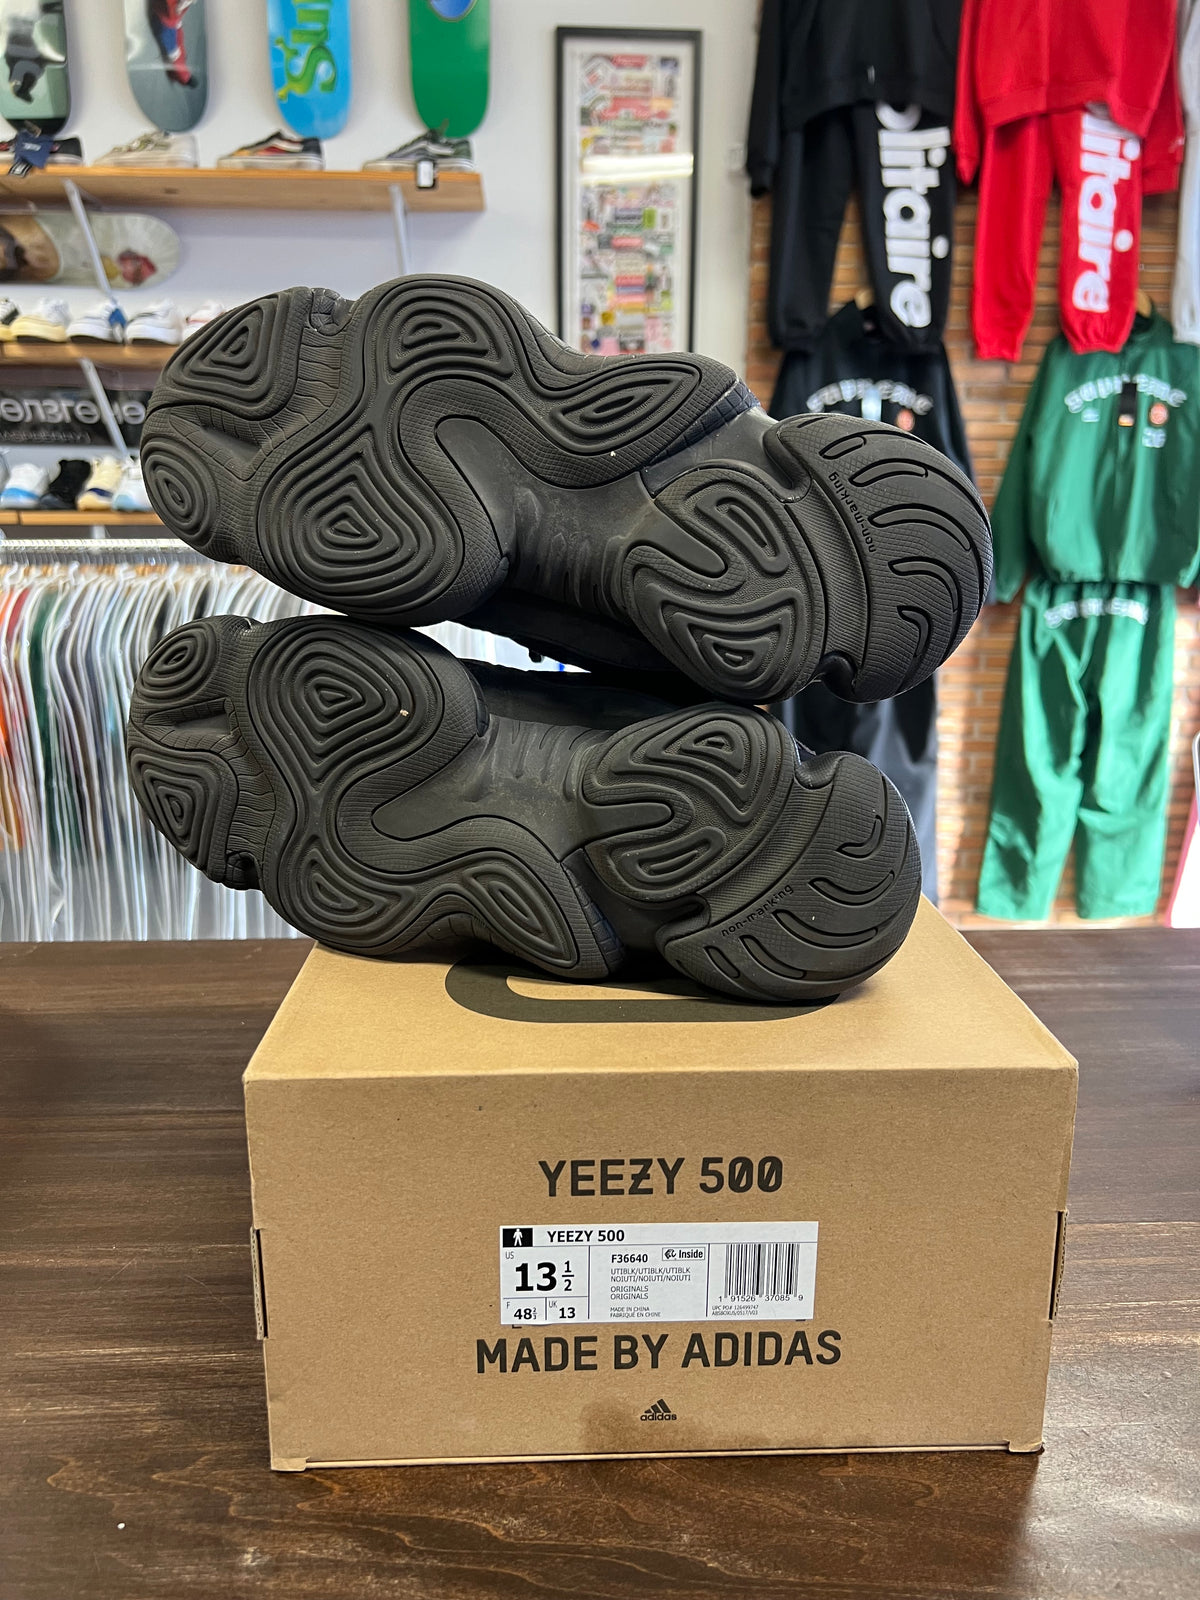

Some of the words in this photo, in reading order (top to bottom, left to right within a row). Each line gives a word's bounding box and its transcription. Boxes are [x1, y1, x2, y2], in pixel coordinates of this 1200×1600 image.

[828, 471, 877, 553] non-marking
[721, 884, 794, 937] non-marking
[538, 1157, 685, 1197] YEEZY
[699, 1156, 783, 1194] 500
[547, 1230, 593, 1243] YEEZY
[597, 1229, 625, 1242] 500
[505, 1251, 514, 1259] US
[611, 1253, 648, 1263] F36640
[678, 1249, 704, 1259] Inside
[515, 1262, 557, 1292] 13
[610, 1285, 649, 1293] ORIGINALS
[765, 1294, 791, 1302] 37085
[548, 1300, 558, 1309] UK
[513, 1308, 532, 1320] 48
[559, 1306, 576, 1319] 13
[476, 1335, 598, 1374] MADE
[613, 1333, 669, 1371] BY
[681, 1329, 842, 1369] ADIDAS
[640, 1412, 677, 1421] adidas
